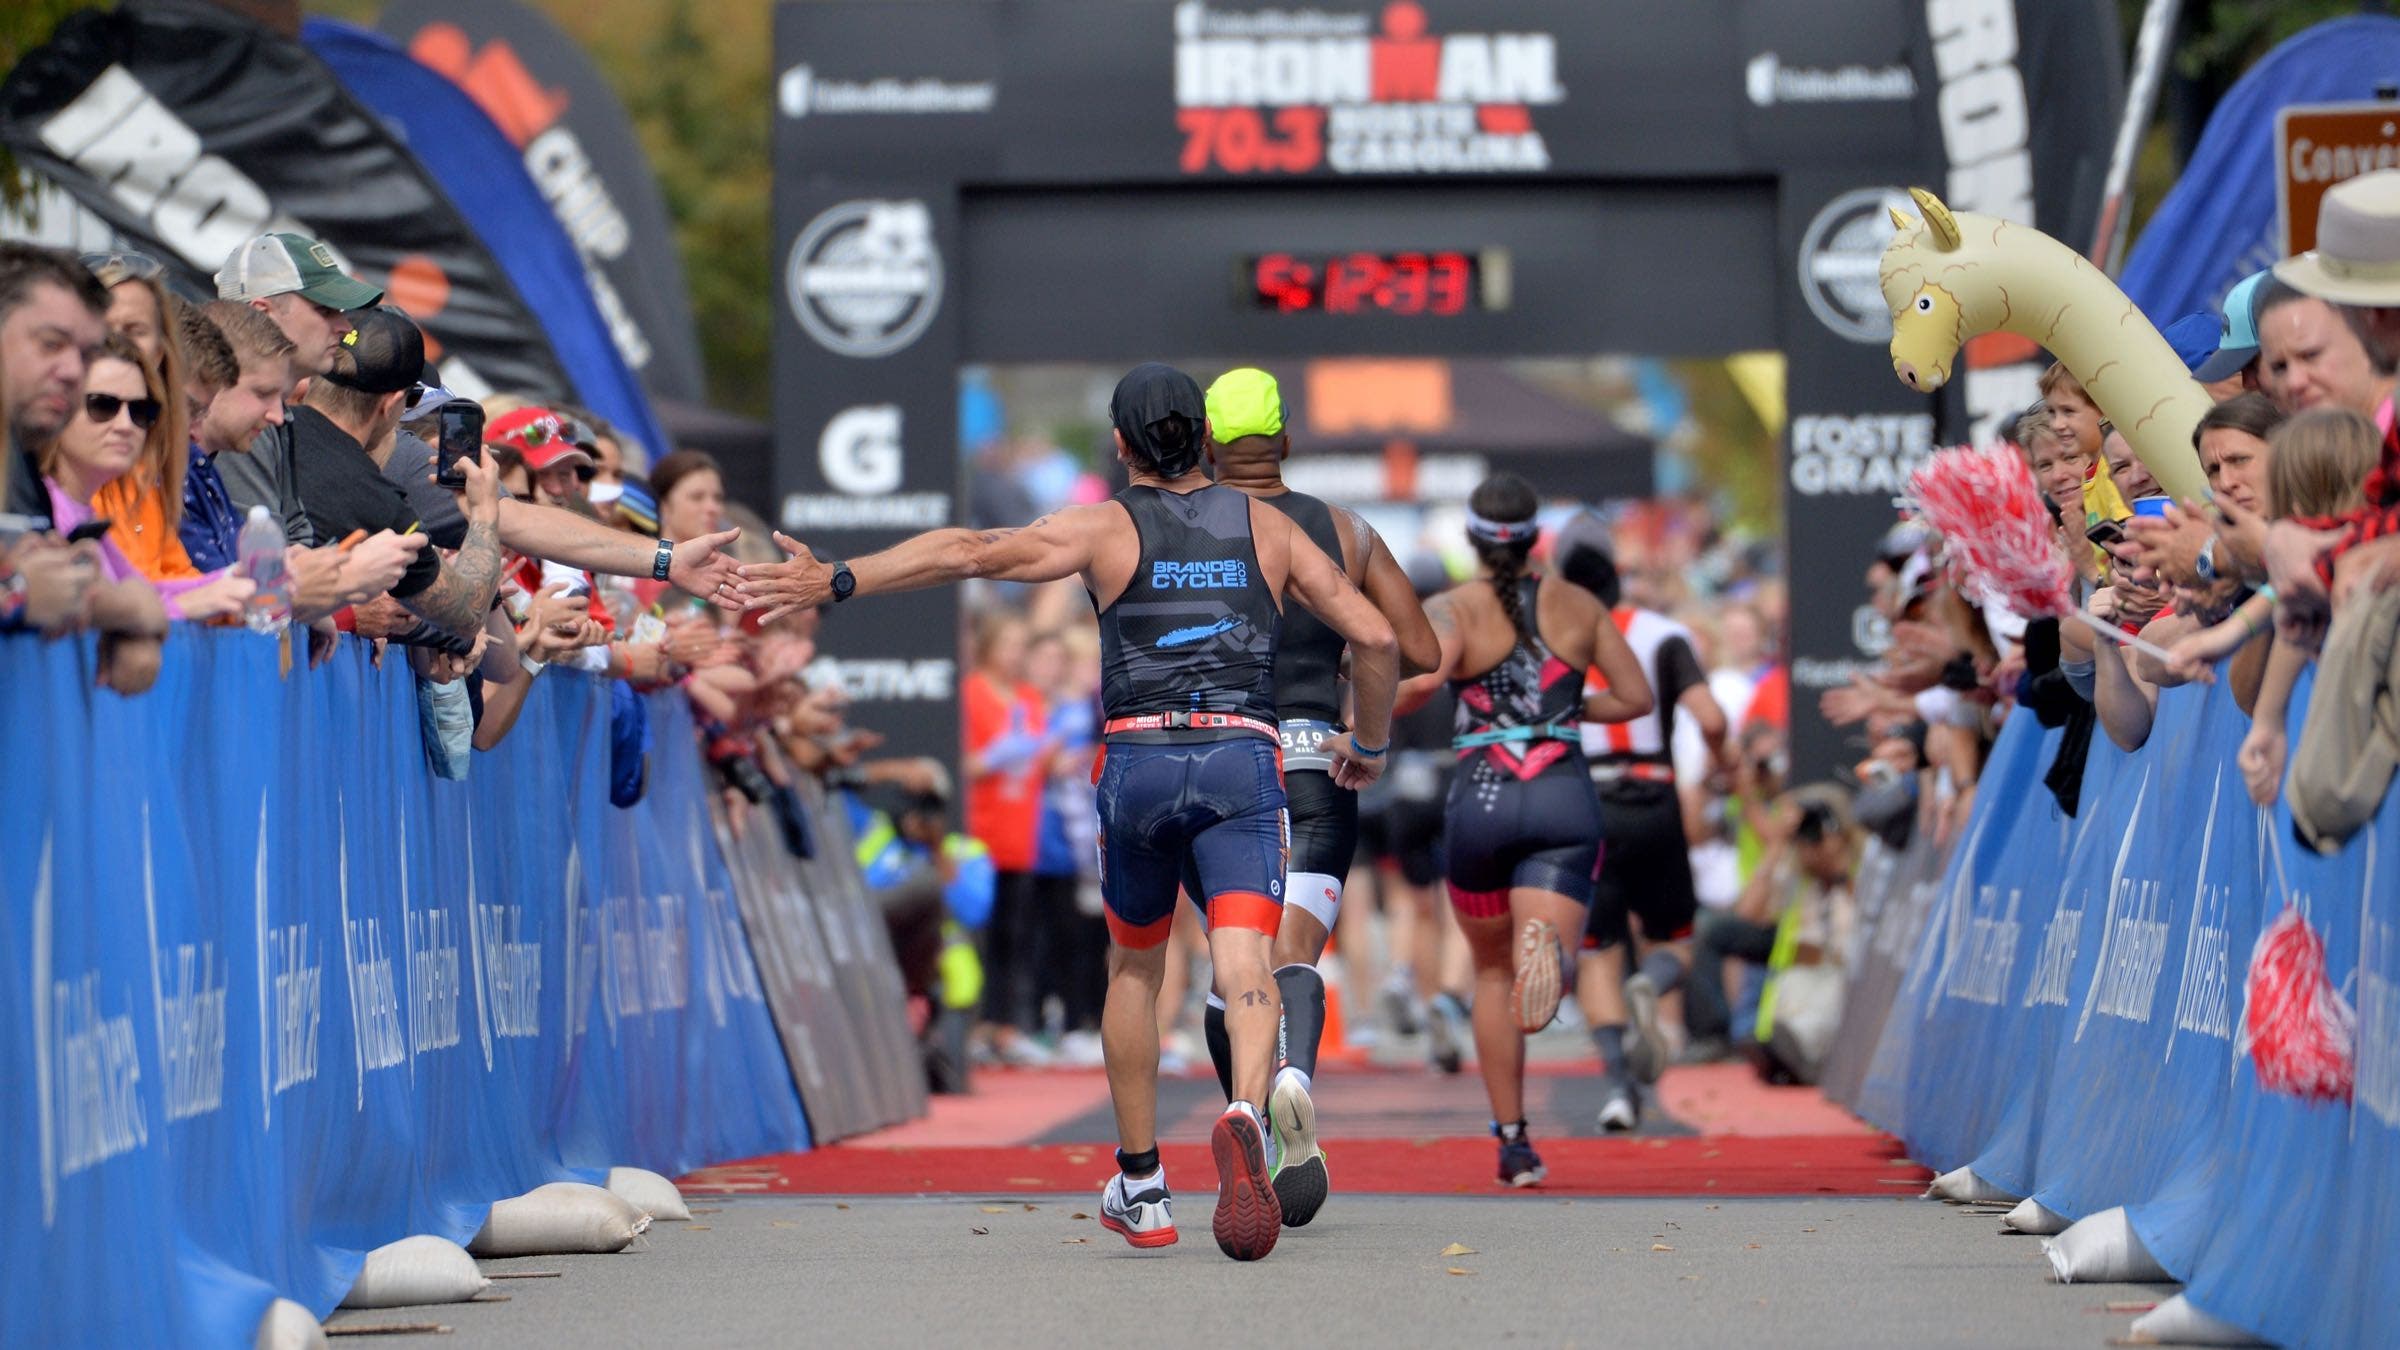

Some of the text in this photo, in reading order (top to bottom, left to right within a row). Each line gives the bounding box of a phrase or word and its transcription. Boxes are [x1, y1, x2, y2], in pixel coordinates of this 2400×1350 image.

[1175, 30, 1560, 105] IRONMAN
[1178, 107, 1326, 173] 70.3
[819, 402, 906, 494] G
[1791, 413, 1936, 456] FOSTE
[1152, 572, 1239, 589] CYCLE
[1153, 559, 1237, 573] BRANDS
[1136, 715, 1162, 724] MIGH
